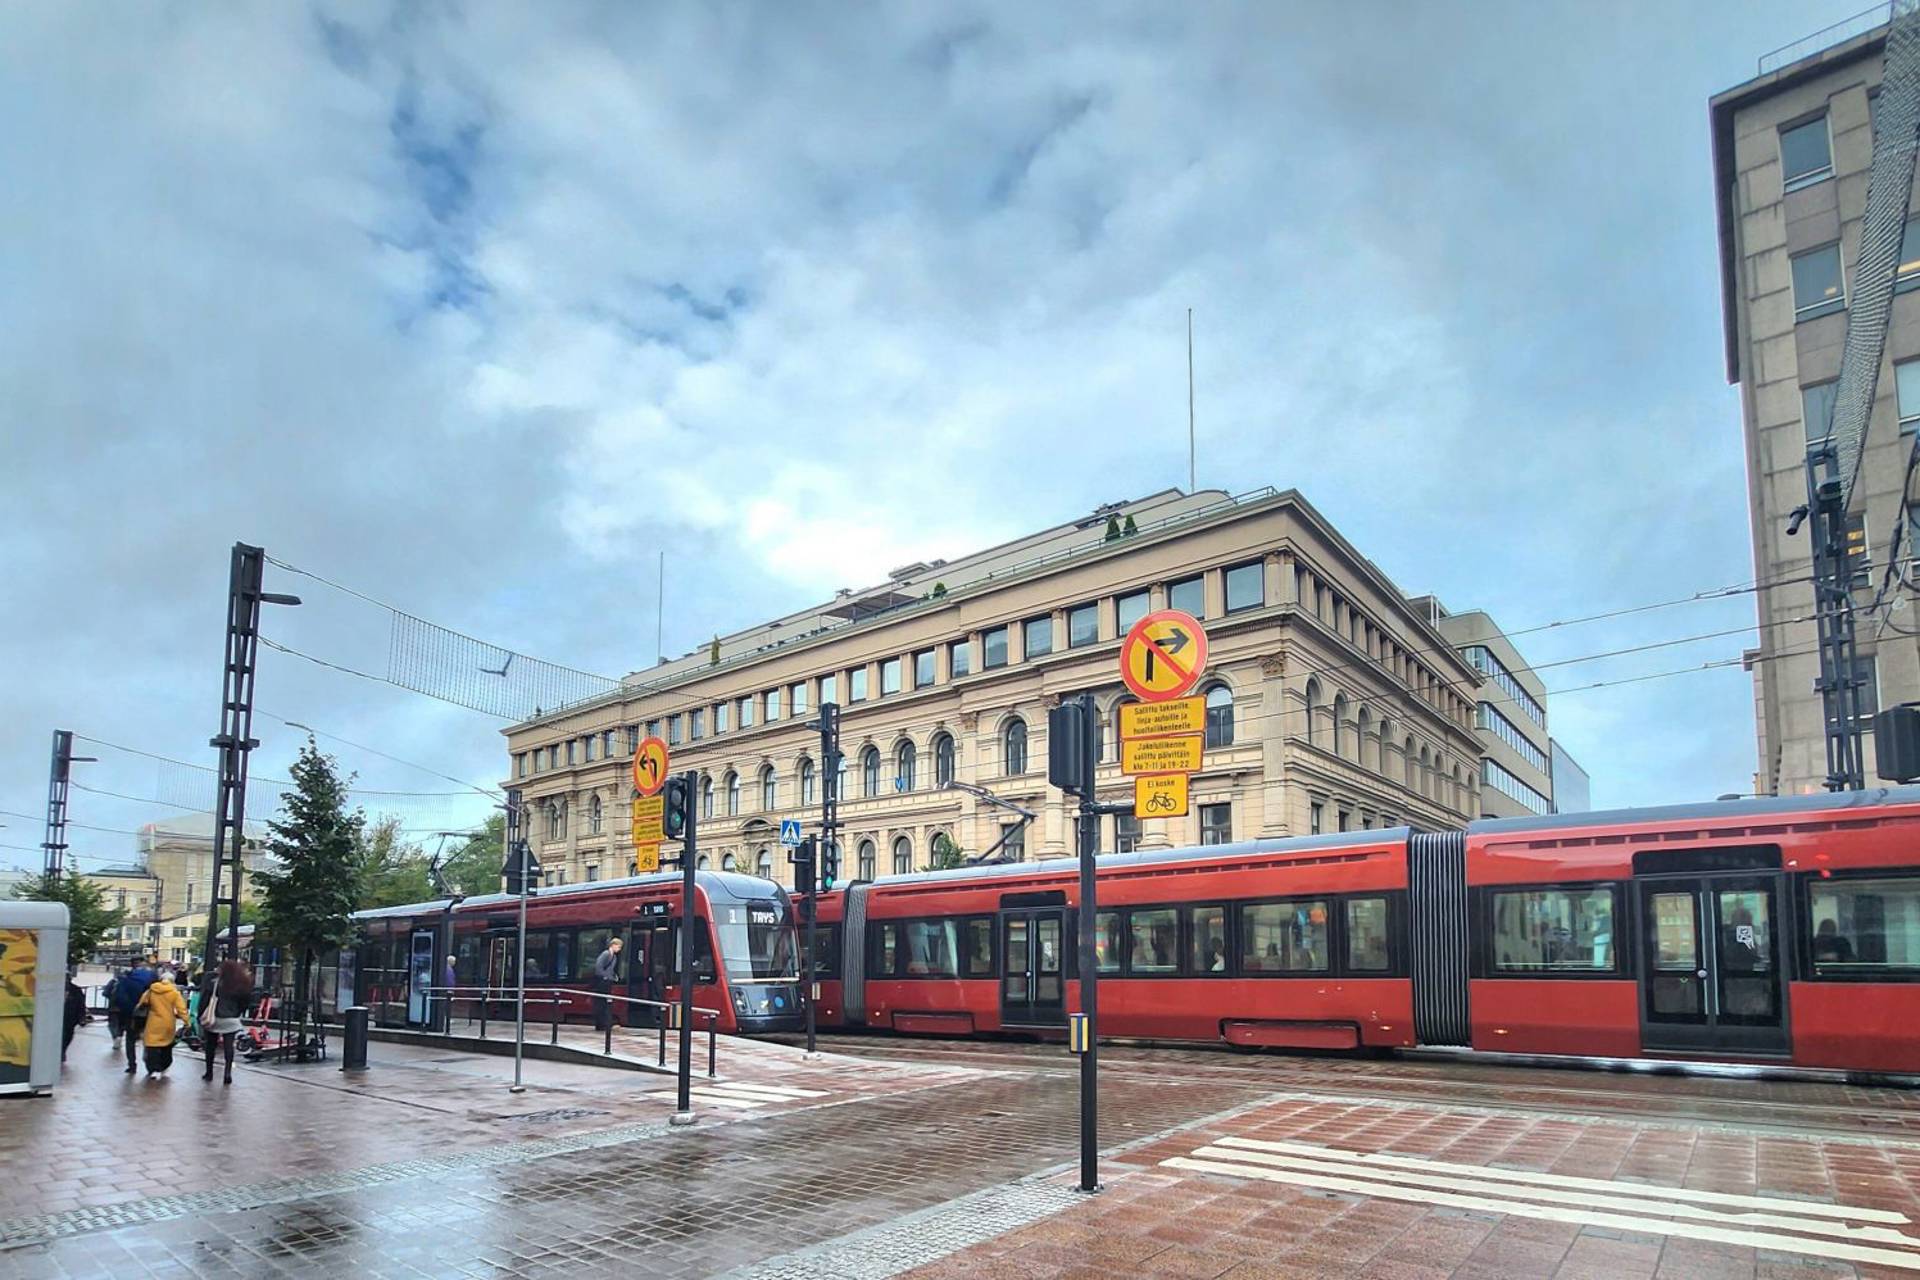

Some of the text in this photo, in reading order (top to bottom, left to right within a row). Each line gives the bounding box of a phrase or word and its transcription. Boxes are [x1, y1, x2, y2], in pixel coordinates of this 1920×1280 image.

[1134, 702, 1188, 715] Sallittu takseille
[1180, 713, 1188, 721] ja
[1133, 722, 1191, 735] huoltoliikenteelle
[1138, 741, 1187, 751] Jakeluliikenne
[1134, 751, 1190, 761] sallittu päivittäin
[1133, 762, 1143, 770] klo
[1159, 762, 1167, 770] ja
[1155, 779, 1175, 787] koske
[729, 909, 775, 924] 1 TAYS
